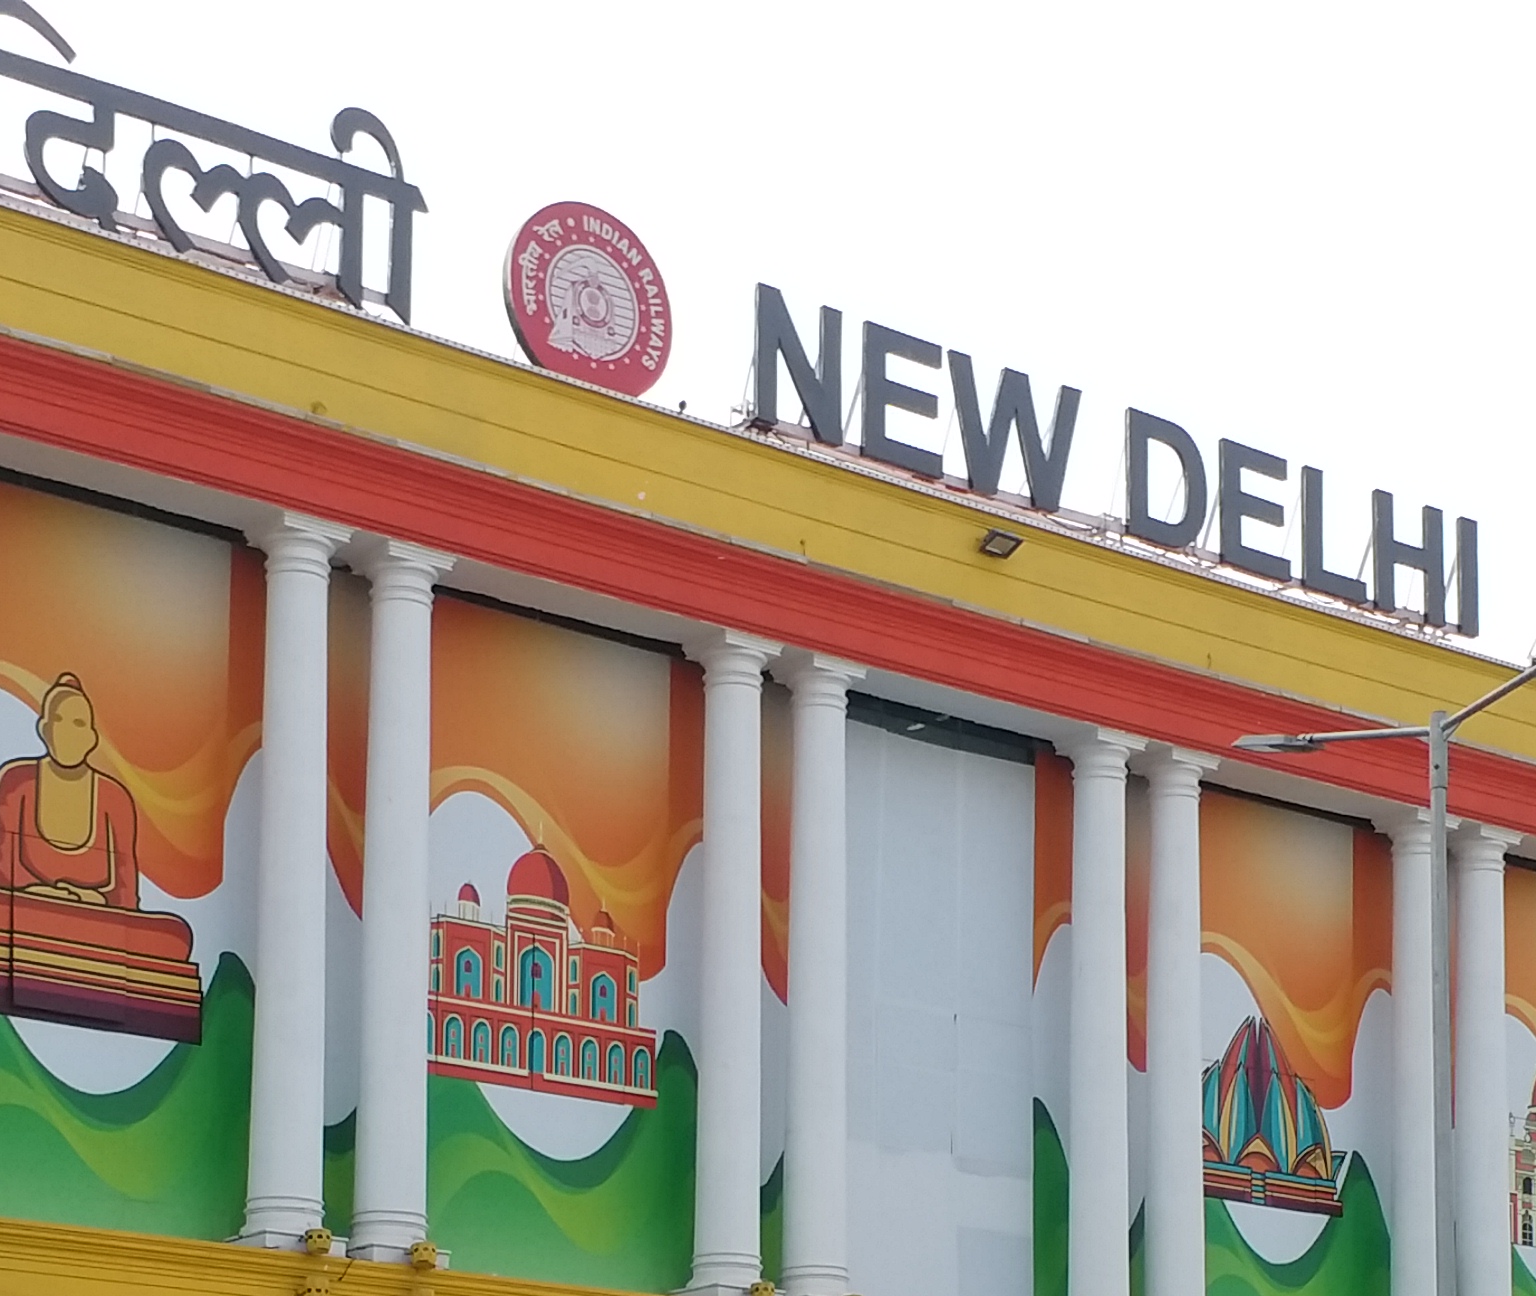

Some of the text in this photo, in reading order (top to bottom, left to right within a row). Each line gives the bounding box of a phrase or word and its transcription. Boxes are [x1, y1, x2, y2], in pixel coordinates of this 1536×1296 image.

[533, 219, 564, 242] रेल
[583, 215, 665, 370] INDIAN RAILWAYS
[754, 282, 1479, 638] NEW DELHI
